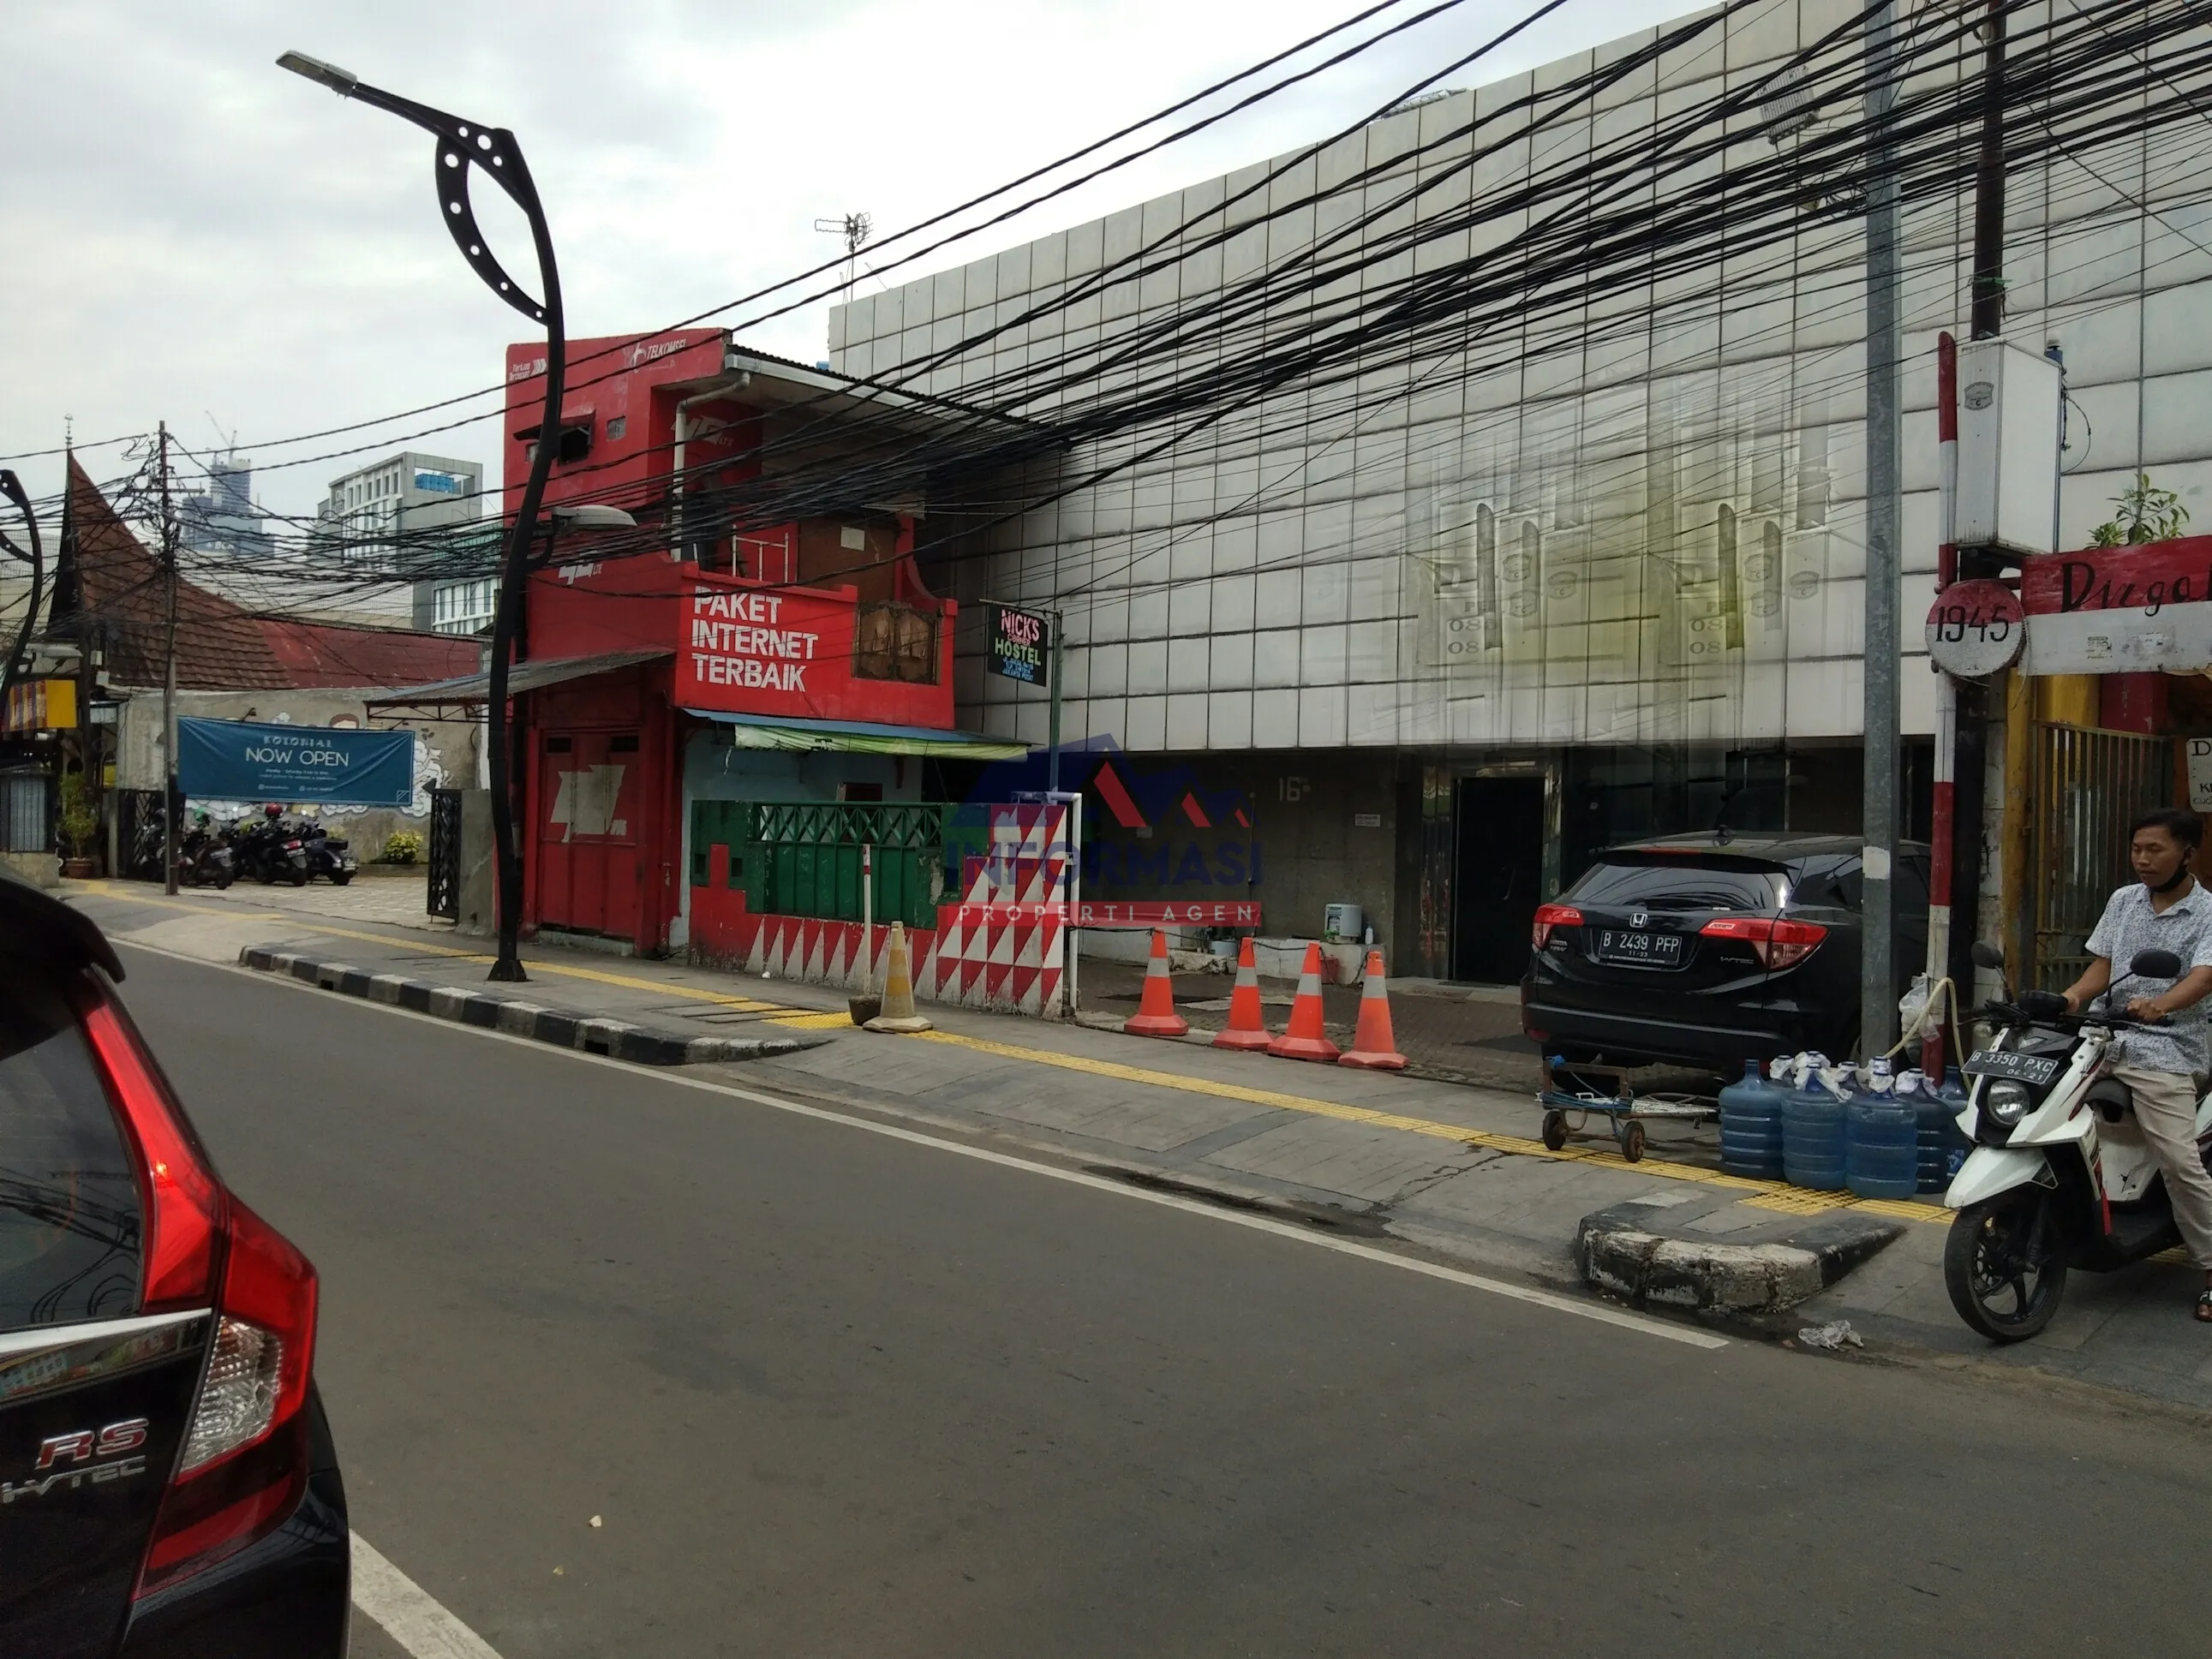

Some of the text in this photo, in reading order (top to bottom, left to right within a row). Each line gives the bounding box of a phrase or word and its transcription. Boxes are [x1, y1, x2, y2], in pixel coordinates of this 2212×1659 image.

[694, 586, 782, 624] PAKET
[691, 618, 818, 659] INTERNET
[1001, 609, 1040, 642] NICK'S
[1936, 605, 2009, 642] 1945
[995, 637, 1042, 666] HOSTEL
[1007, 634, 1031, 647] CORNER
[691, 653, 807, 692] TERBAIK
[245, 747, 350, 767] NOW OPEN
[1603, 932, 1680, 953] B 2439 PFP
[1971, 1052, 2054, 1072] B 3350 PXC
[34, 1417, 149, 1470] RS
